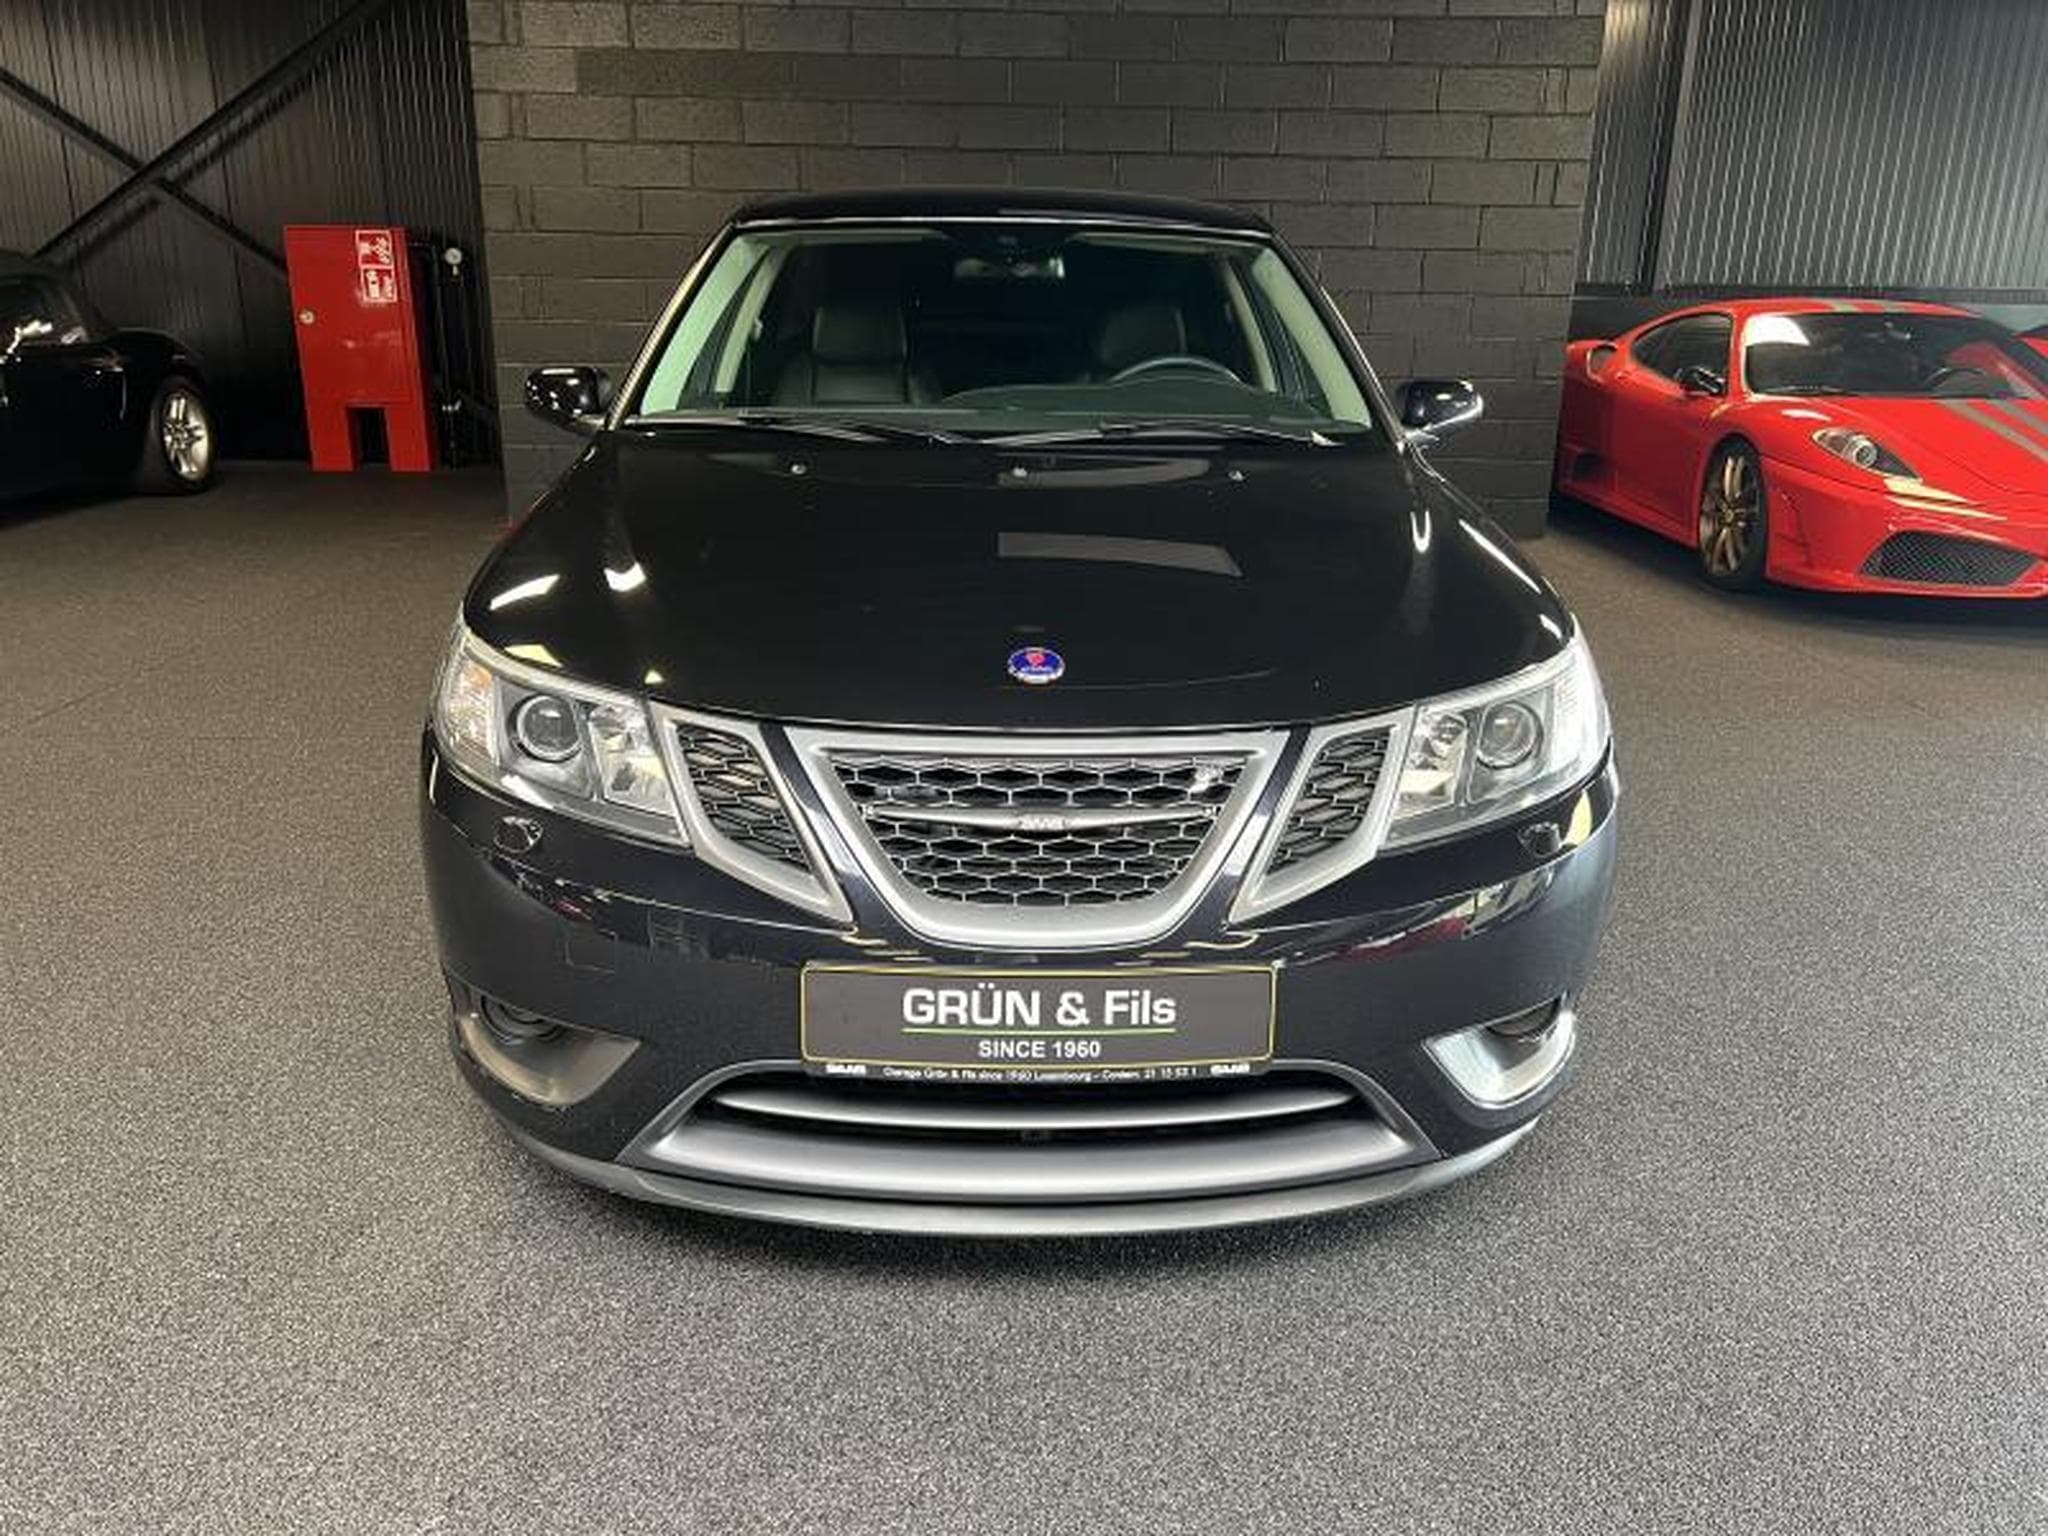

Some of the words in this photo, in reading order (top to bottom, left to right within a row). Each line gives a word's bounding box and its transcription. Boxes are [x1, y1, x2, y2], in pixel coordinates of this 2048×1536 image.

[903, 983, 1040, 1026] GRÜN
[1055, 991, 1090, 1026] &
[1104, 989, 1177, 1025] Fils
[978, 1041, 1045, 1058] SINCE
[1052, 1041, 1101, 1058] 1960
